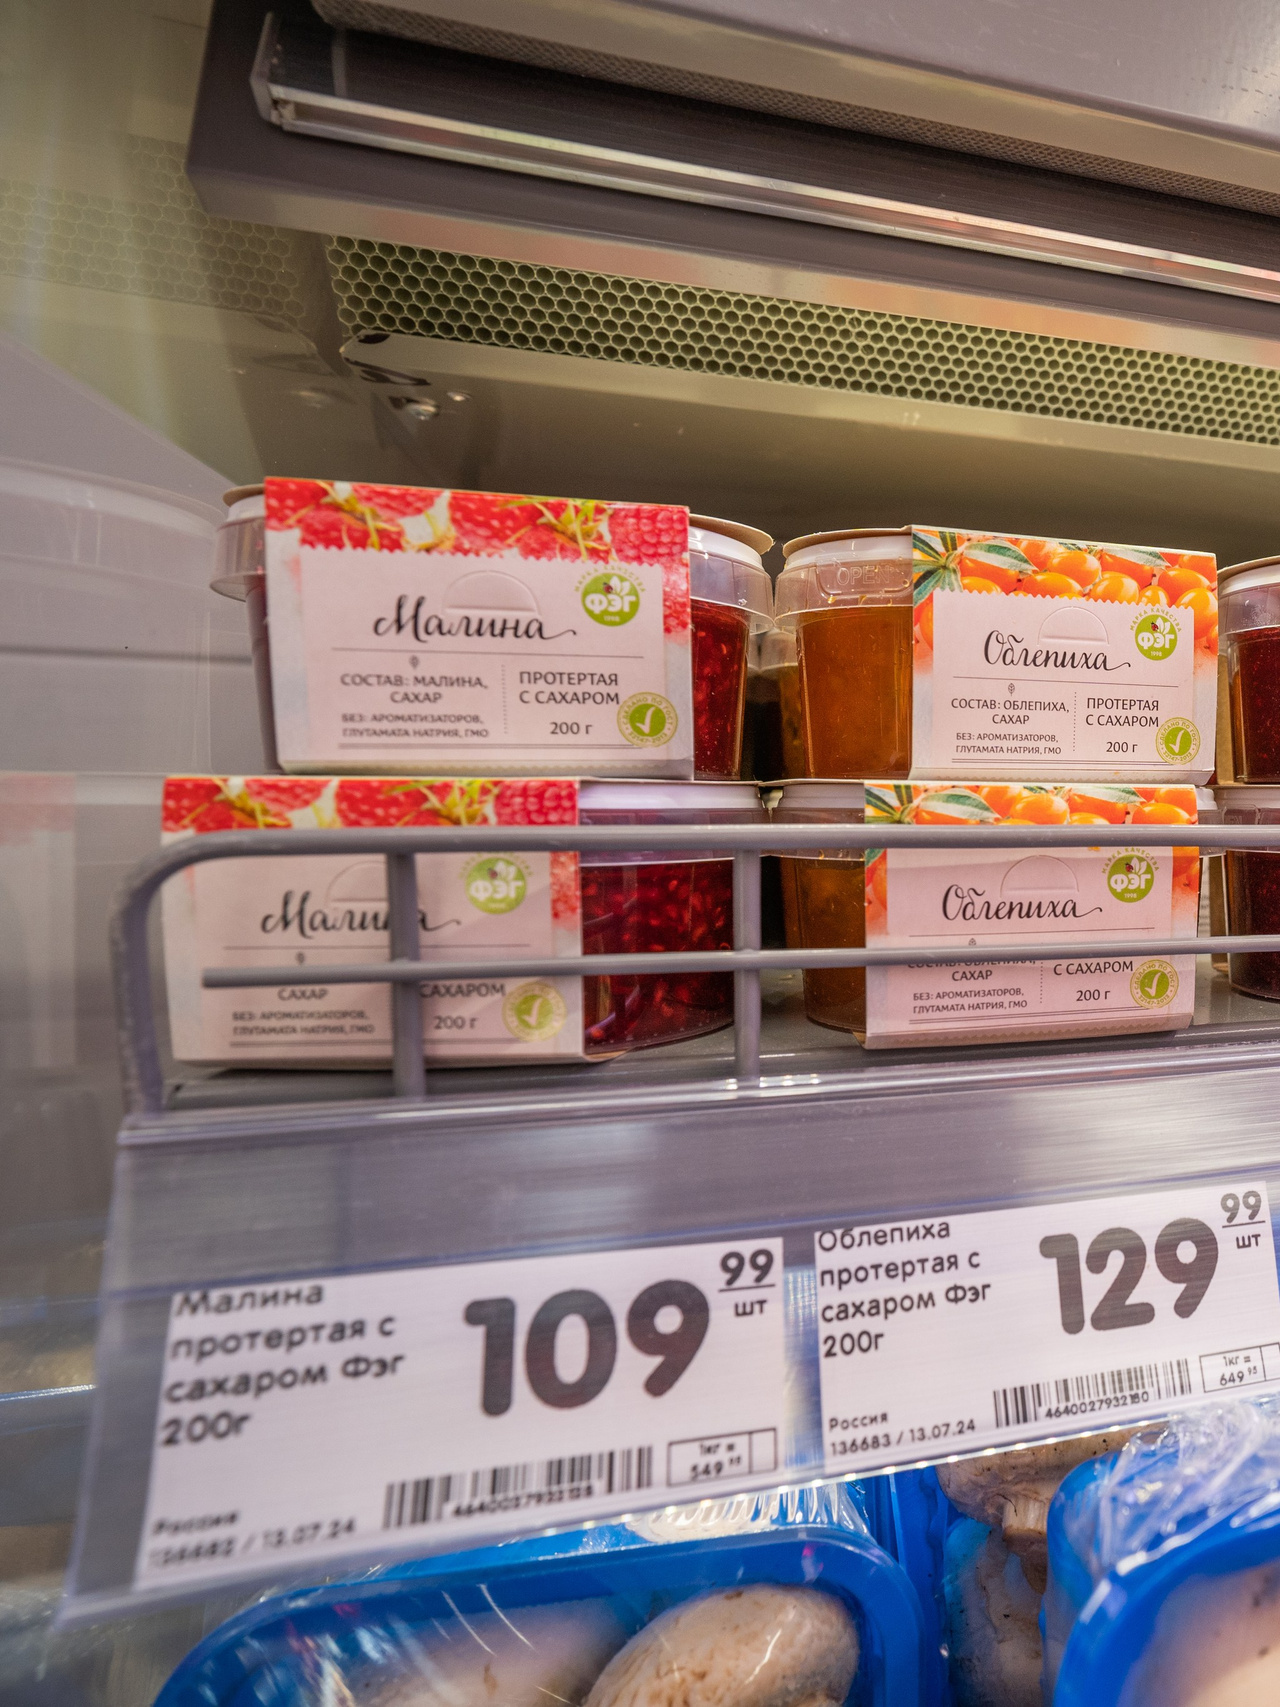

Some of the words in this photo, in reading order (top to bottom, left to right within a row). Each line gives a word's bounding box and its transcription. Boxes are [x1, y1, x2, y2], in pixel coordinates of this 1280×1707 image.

[585, 593, 636, 614] ФЭГ
[372, 593, 577, 642] Малина
[983, 630, 1131, 671] Облепиха
[1137, 632, 1175, 650] ФЭГ
[340, 673, 410, 687] СОСТАВ:
[413, 675, 488, 689] МАЛИНА,
[519, 671, 619, 686] ПРОТЕРТАЯ
[390, 691, 442, 704] САХАР
[519, 691, 530, 704] С
[534, 691, 620, 705] САХАРОМ
[951, 698, 1000, 710] СОСТАВ:
[1003, 699, 1069, 713] ОБЛЕПИХА,
[1086, 697, 1159, 712] ПРОТЕРТАЯ
[549, 721, 579, 735] 200
[585, 724, 593, 735] г
[992, 714, 1030, 725] САХАР
[1086, 715, 1094, 726] С
[1096, 714, 1159, 727] САХАРОМ
[956, 732, 975, 741] БЕЗ:
[976, 733, 1059, 744] АРОМАТИЗАТОРОВ,
[1106, 741, 1129, 753] 200
[1132, 743, 1138, 753] г
[955, 745, 1004, 755] ГЛУТАМАТА
[1006, 746, 1042, 755] НАТРИЯ,
[1044, 746, 1062, 755] ГМО
[470, 880, 523, 902] ФЭГ
[1110, 873, 1151, 893] ФЭГ
[942, 884, 1102, 921] Облепиха
[260, 889, 461, 939] Малиа
[951, 970, 993, 982] САХАР
[1053, 964, 1063, 976] С
[1065, 961, 1134, 975] САХАРОМ
[818, 1222, 951, 1253] Облепиха
[1234, 1232, 1262, 1250] шт
[819, 1255, 959, 1290] протертая
[968, 1252, 981, 1268] с
[1039, 1216, 1219, 1335] 129
[1220, 1190, 1262, 1225] 99
[174, 1278, 326, 1319] Малина
[734, 1296, 770, 1319] шт
[821, 1293, 936, 1324] сахаром
[945, 1281, 991, 1305] Фэг
[169, 1318, 365, 1361] протертая
[378, 1313, 397, 1337] с
[463, 1277, 711, 1419] 109
[718, 1247, 775, 1287] 99
[823, 1330, 885, 1359] 200г
[1223, 1355, 1240, 1368] 1кг
[162, 1361, 329, 1404] сахаром
[340, 1349, 406, 1380] Фэг
[1219, 1370, 1245, 1387] 649
[160, 1408, 252, 1447] 200г
[829, 1411, 889, 1433] Россия
[830, 1433, 892, 1458] 136683
[909, 1419, 976, 1442] 13.07.24
[1045, 1391, 1150, 1419] 4640027932180
